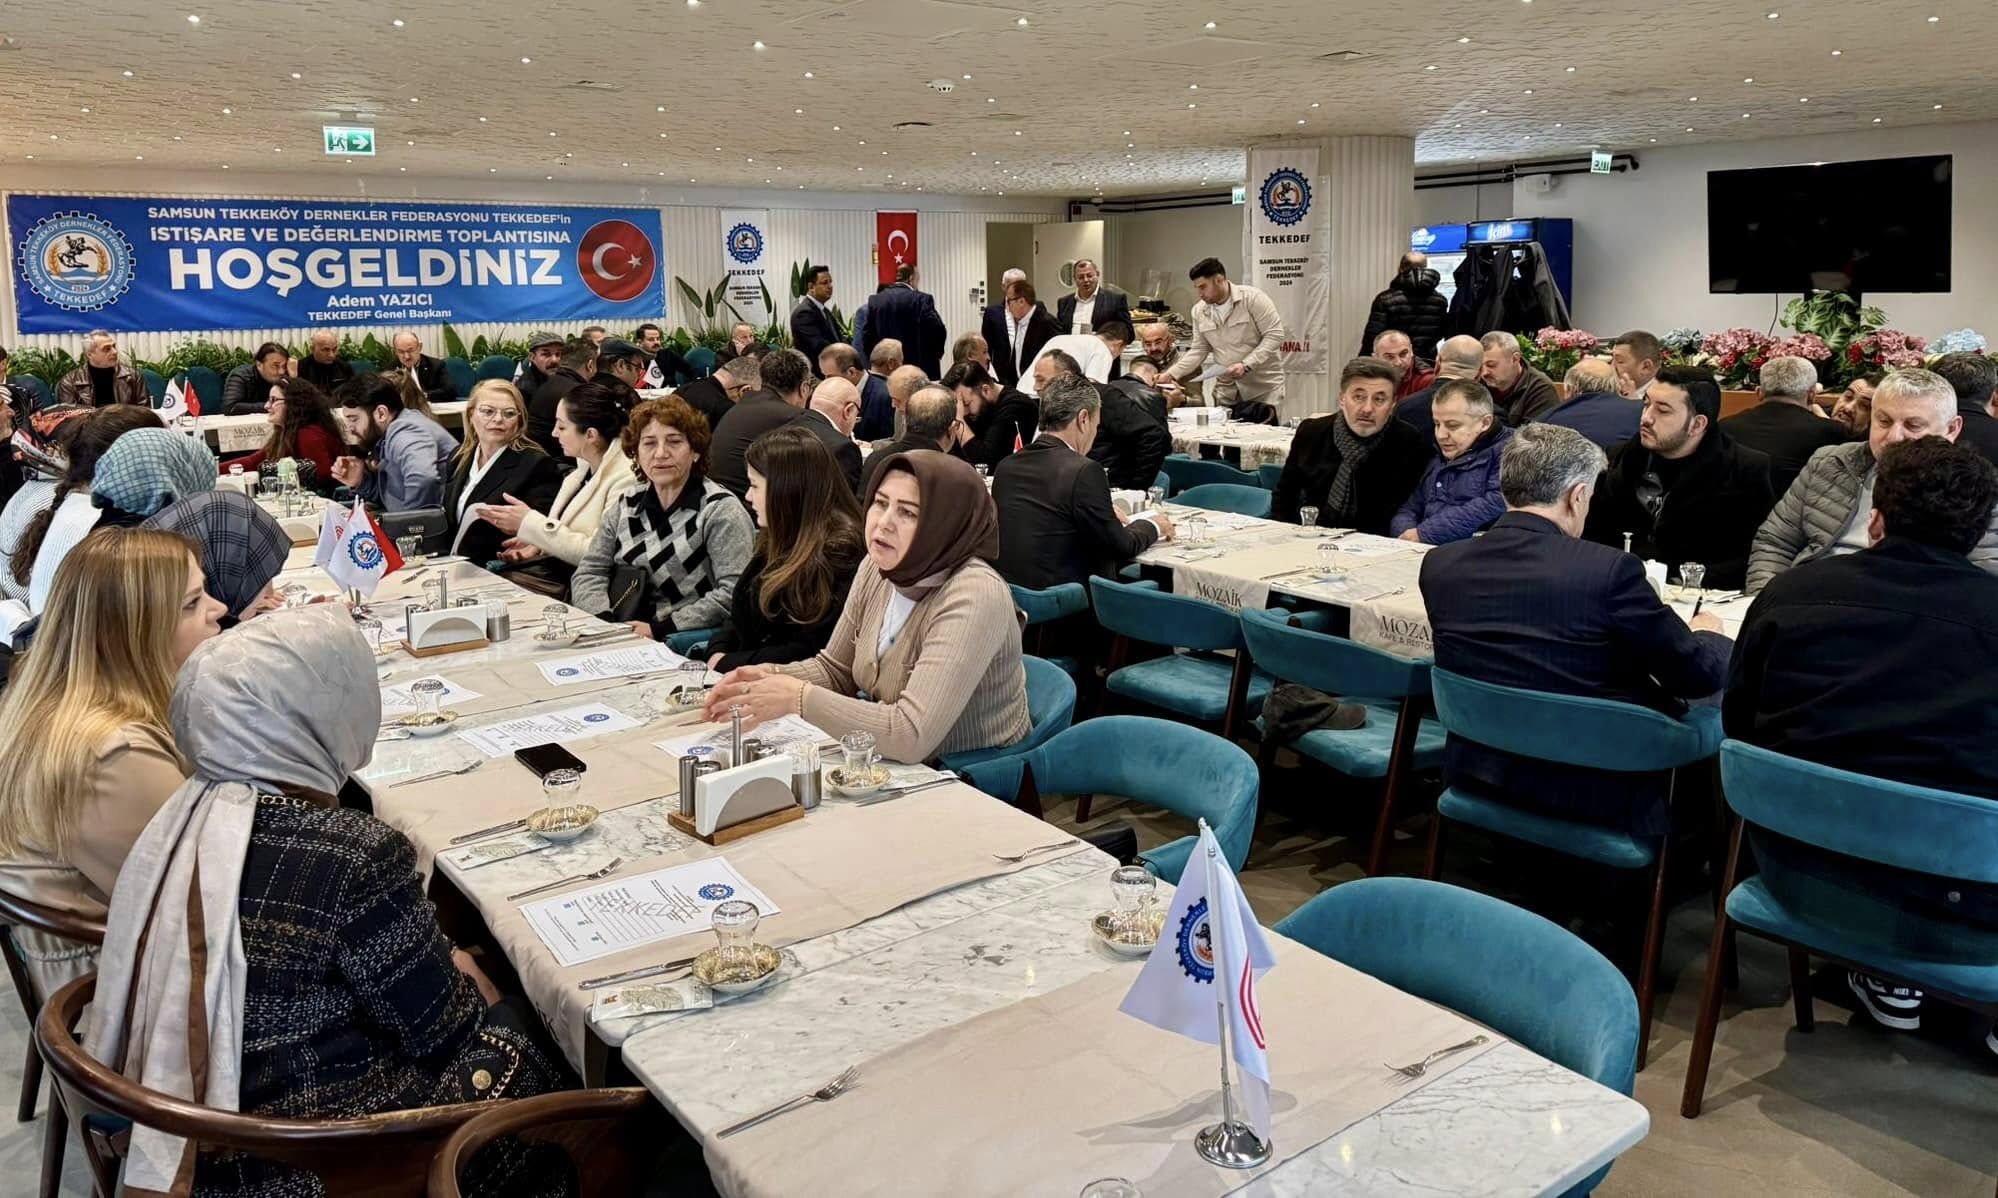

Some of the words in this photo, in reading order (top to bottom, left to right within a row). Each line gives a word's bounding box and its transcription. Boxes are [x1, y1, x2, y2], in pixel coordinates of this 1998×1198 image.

[148, 207, 216, 220] SAMSUN
[219, 207, 299, 221] TEKKEKÖY
[303, 210, 388, 222] DERNEKLER
[391, 211, 489, 224] FEDERASYONU
[250, 227, 279, 242] VE
[284, 225, 442, 243] DEĞERLENDİRME
[446, 229, 571, 243] TOPLANTISINA
[1258, 234, 1311, 245] TEKKEDEF
[53, 290, 108, 304] TEKKEDEF
[327, 294, 375, 307] Adem
[379, 293, 433, 306] YAZICI
[307, 310, 371, 321] TEKKEDEF
[374, 309, 406, 320] Genel
[409, 309, 452, 320] Başkanı
[1196, 581, 1242, 608] MOZAİK
[1379, 615, 1430, 642] MOZA
